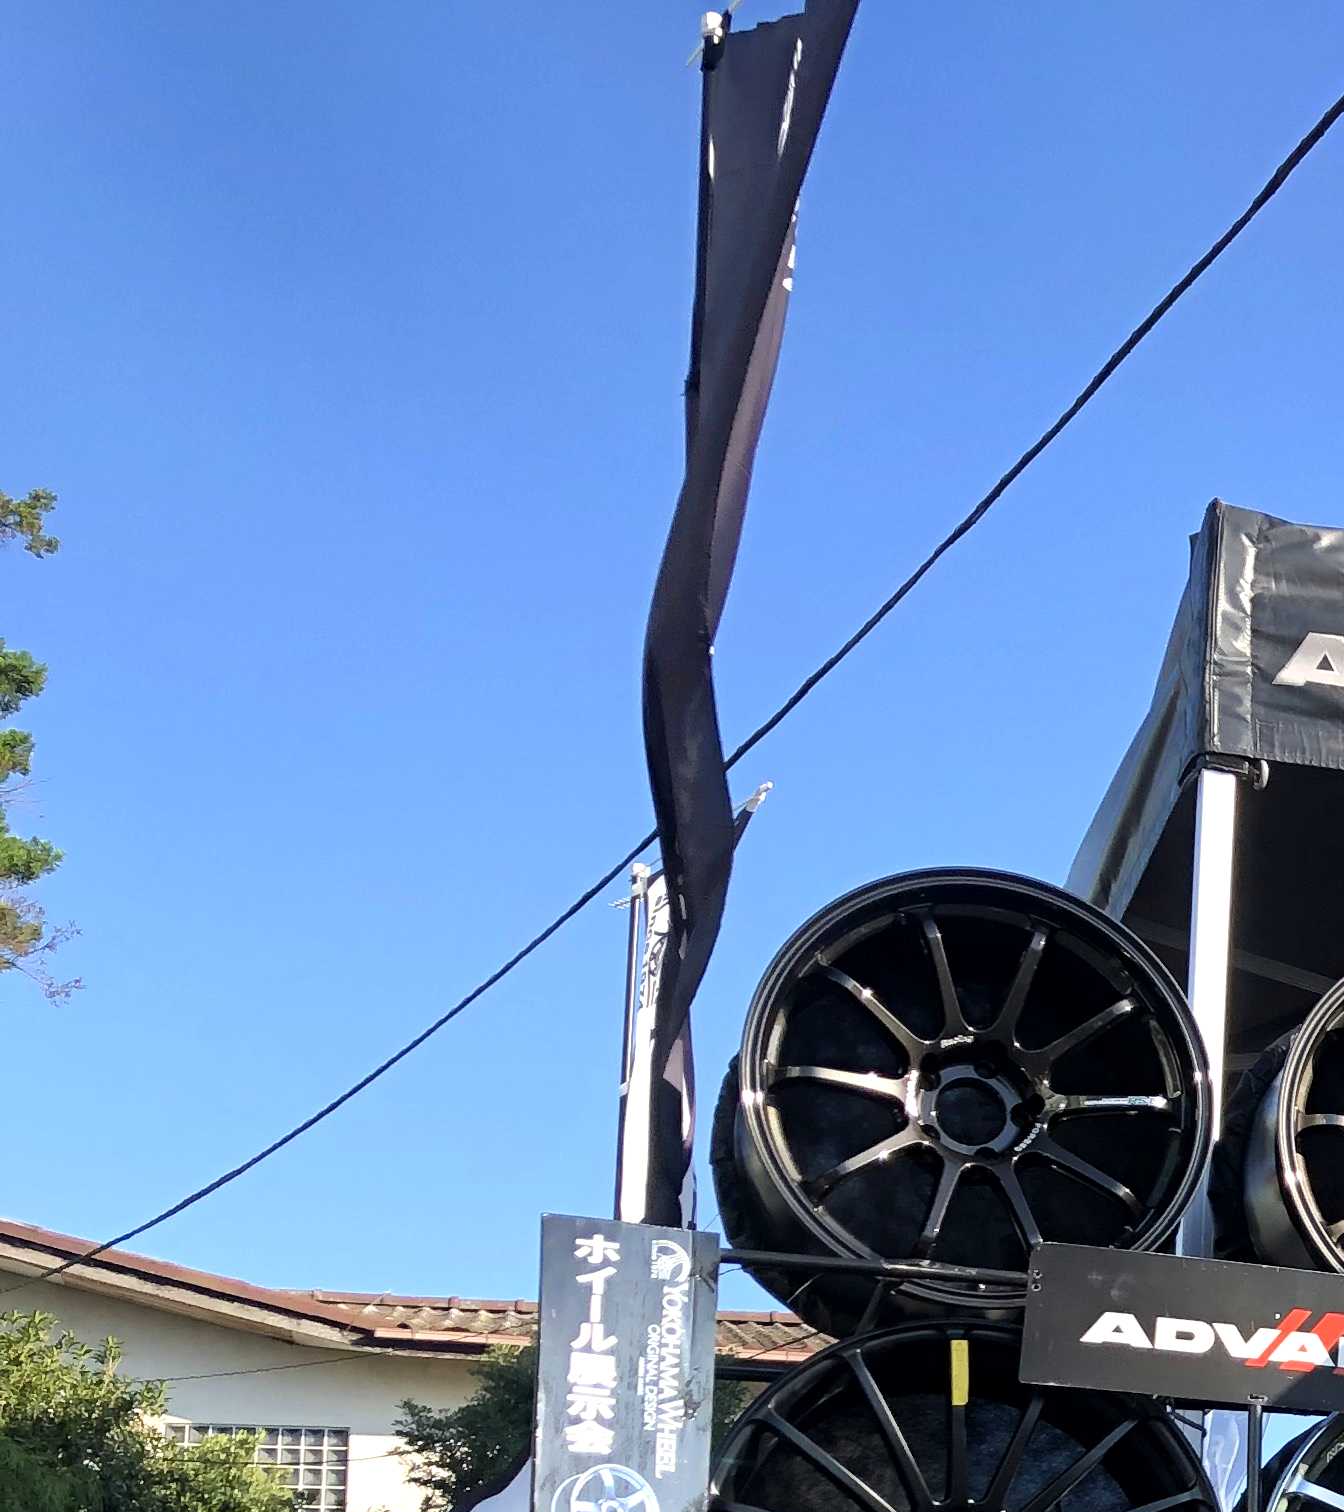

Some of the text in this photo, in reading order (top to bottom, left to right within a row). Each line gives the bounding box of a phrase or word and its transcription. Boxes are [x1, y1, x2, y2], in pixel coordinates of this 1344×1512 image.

[562, 1233, 621, 1455] ホイール展示会
[655, 1283, 690, 1480] YOKOHAMA WHEEL
